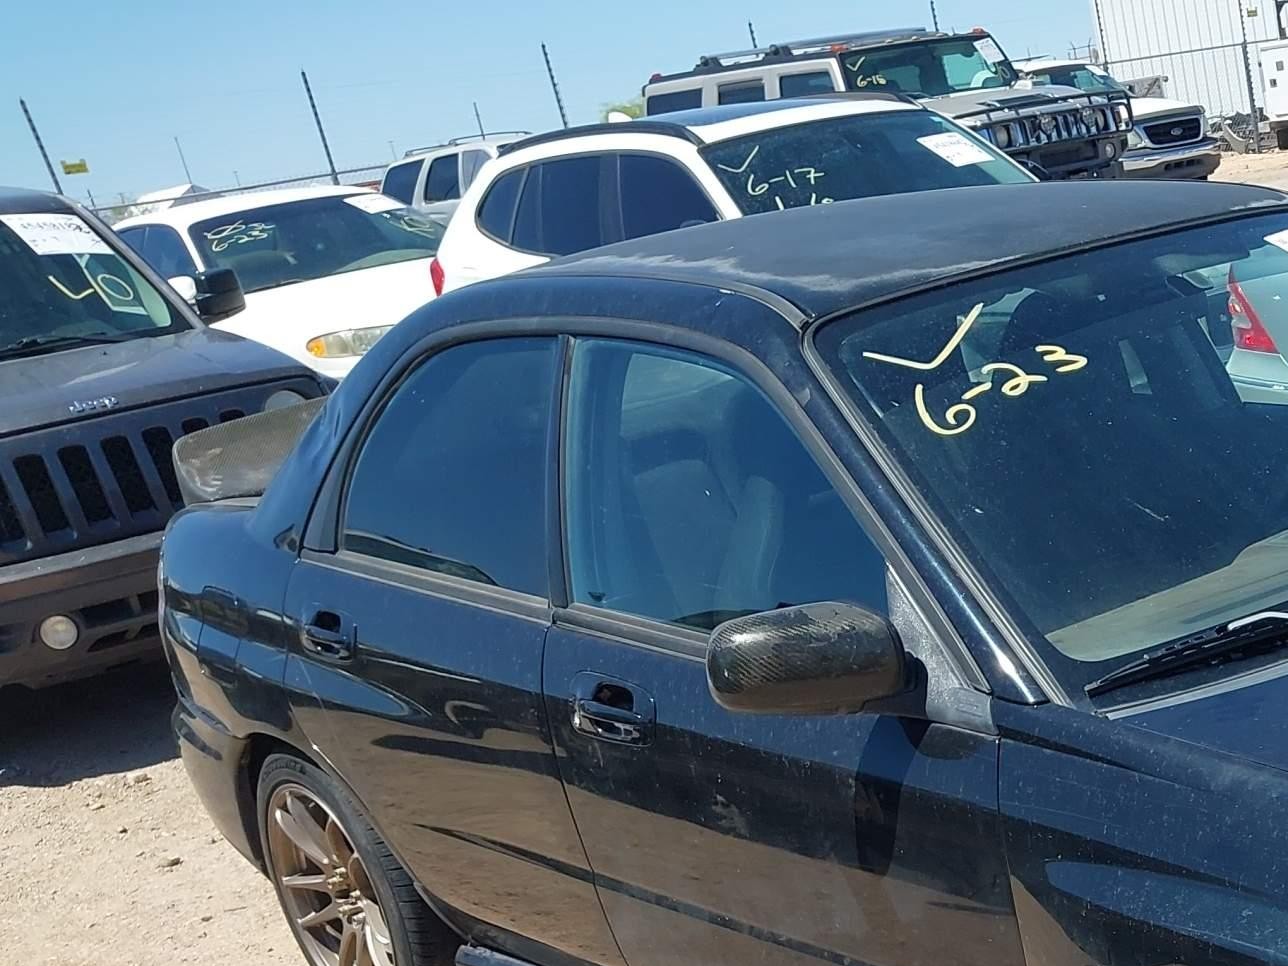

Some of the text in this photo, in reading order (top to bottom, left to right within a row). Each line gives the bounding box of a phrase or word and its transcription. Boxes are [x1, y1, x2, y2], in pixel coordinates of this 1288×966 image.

[747, 167, 825, 196] 6-17
[212, 230, 268, 252] 6-23
[914, 344, 1088, 436] 6-23
